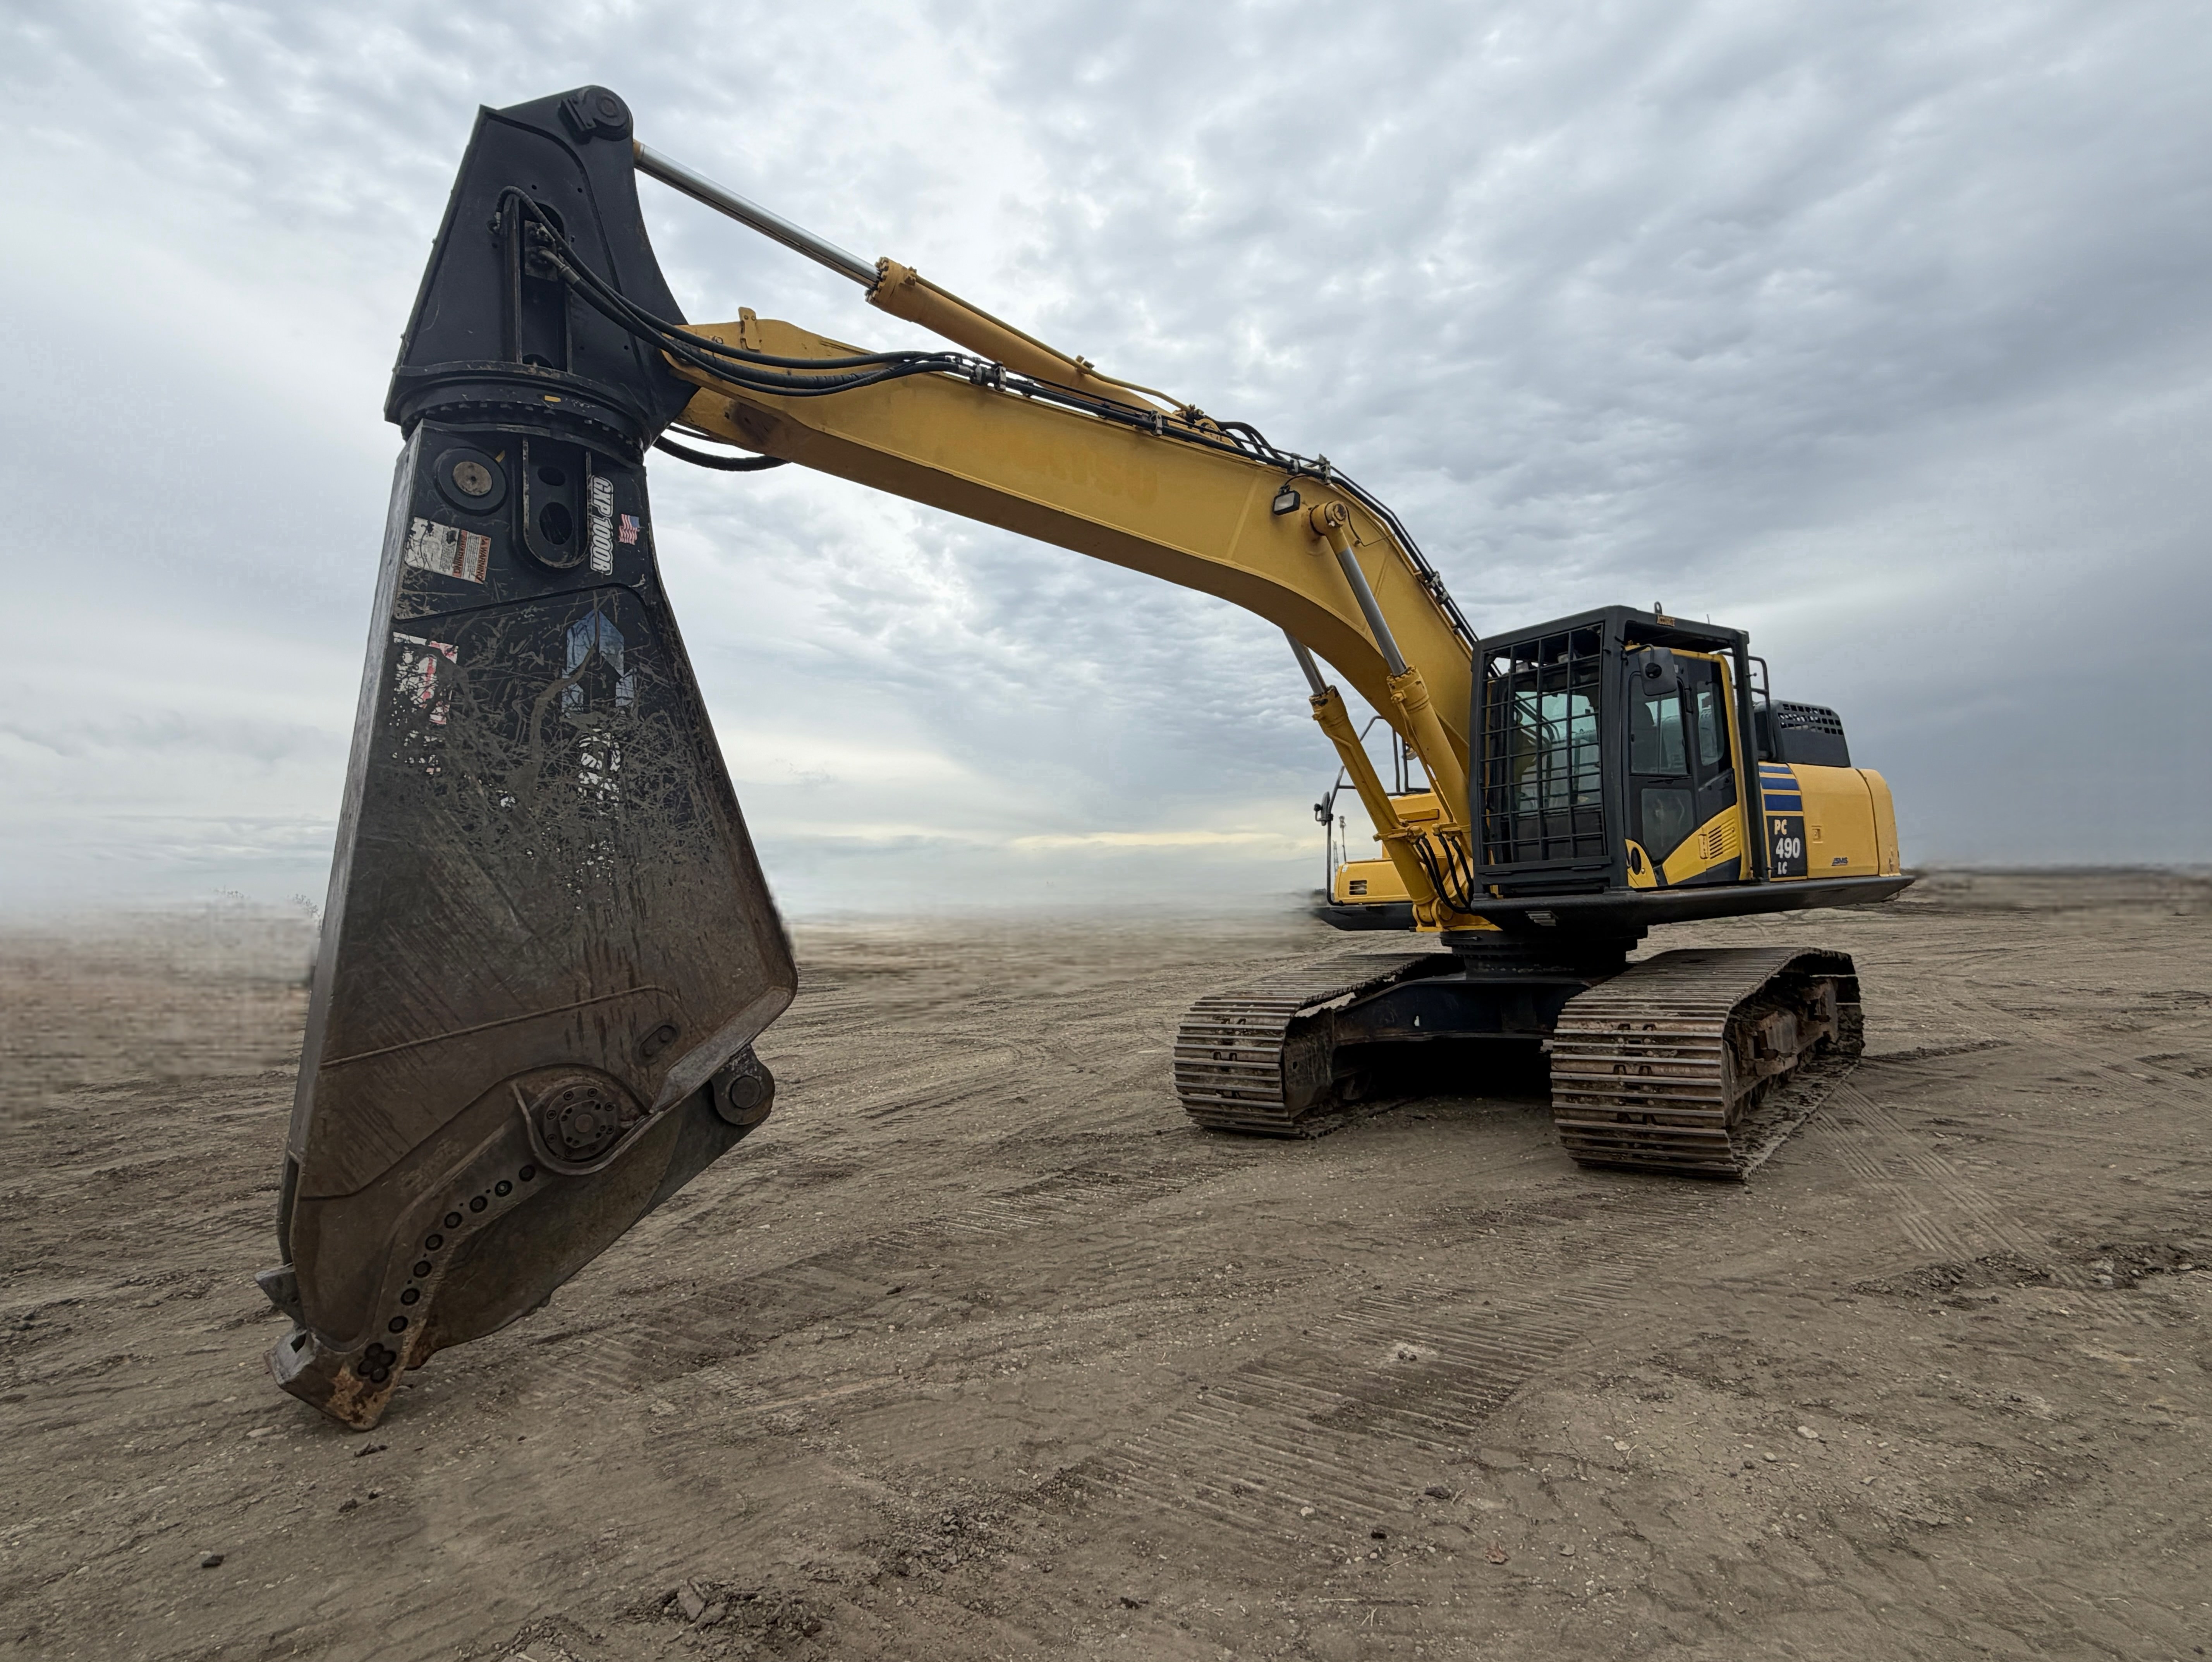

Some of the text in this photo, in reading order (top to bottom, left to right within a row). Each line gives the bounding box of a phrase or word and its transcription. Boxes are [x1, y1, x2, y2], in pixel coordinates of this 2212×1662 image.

[591, 476, 612, 573] GXP 1000R
[476, 547, 487, 579] WARNING
[1774, 819, 1787, 835] PC
[1775, 837, 1801, 858] 490
[1778, 861, 1788, 875] LC
